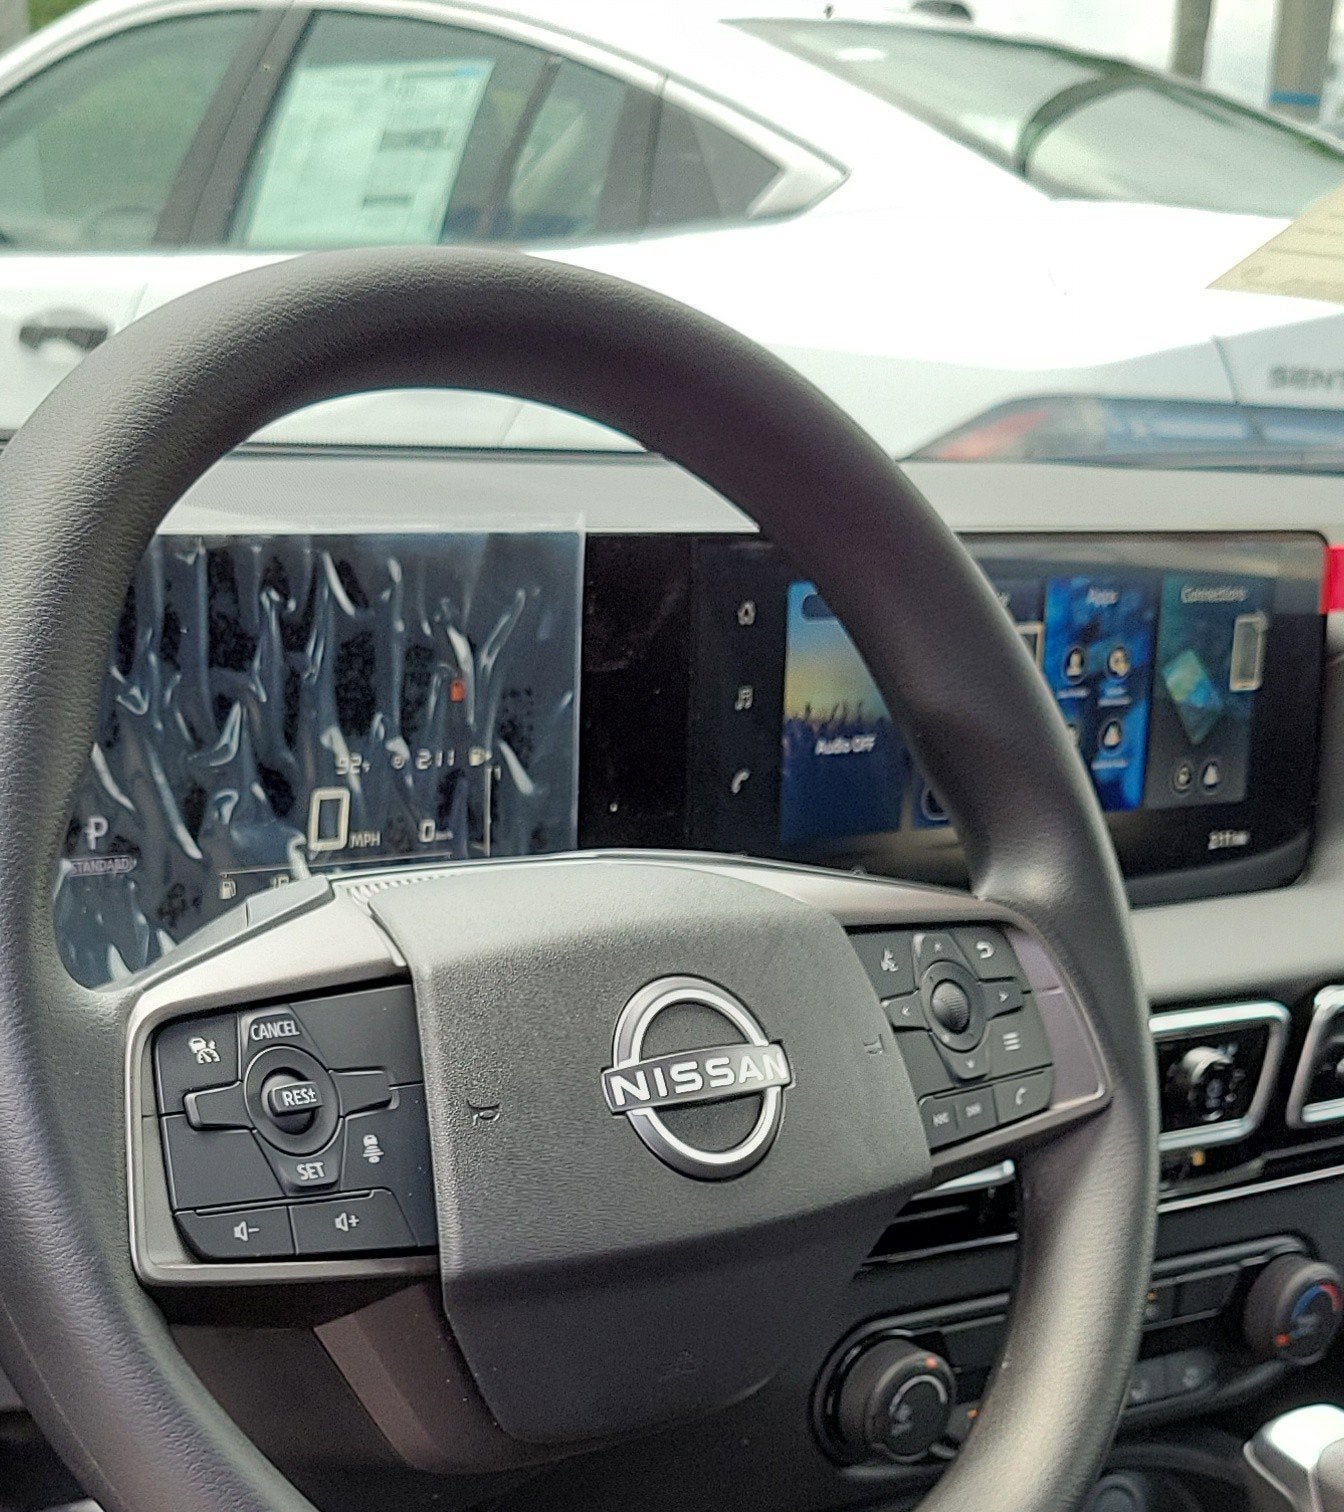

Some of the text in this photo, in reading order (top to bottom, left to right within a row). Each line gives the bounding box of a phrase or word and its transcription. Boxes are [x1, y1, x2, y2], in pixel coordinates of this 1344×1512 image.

[349, 831, 381, 849] MPH
[250, 1020, 301, 1042] CANCEL
[609, 1052, 788, 1106] NISSAN
[296, 1161, 325, 1181] SET
